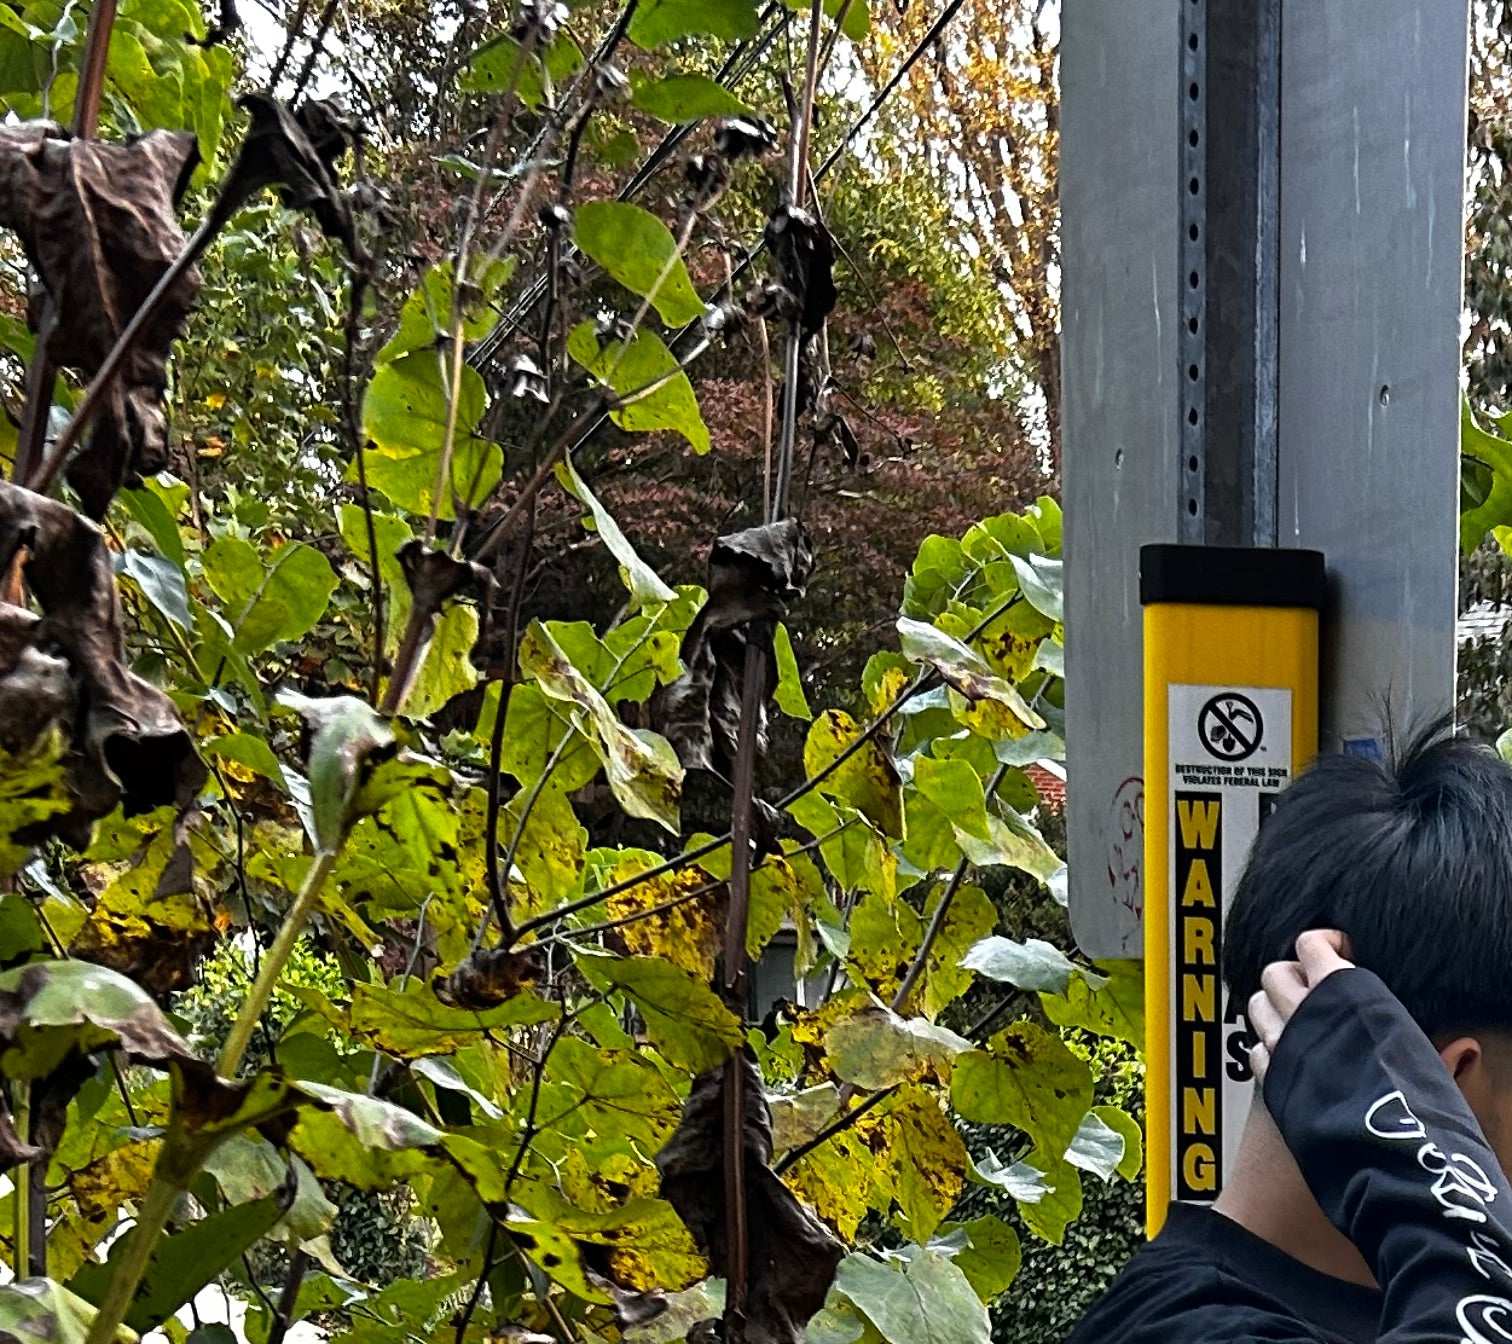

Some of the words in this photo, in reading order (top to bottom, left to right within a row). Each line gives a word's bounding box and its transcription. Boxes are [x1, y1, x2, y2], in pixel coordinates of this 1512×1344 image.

[1175, 765, 1232, 775] DESTRUCTION
[1234, 766, 1245, 776] OF
[1183, 776, 1222, 785] VIOLATES
[1224, 776, 1259, 787] FEDERAL
[1177, 800, 1220, 1192] WARNING
